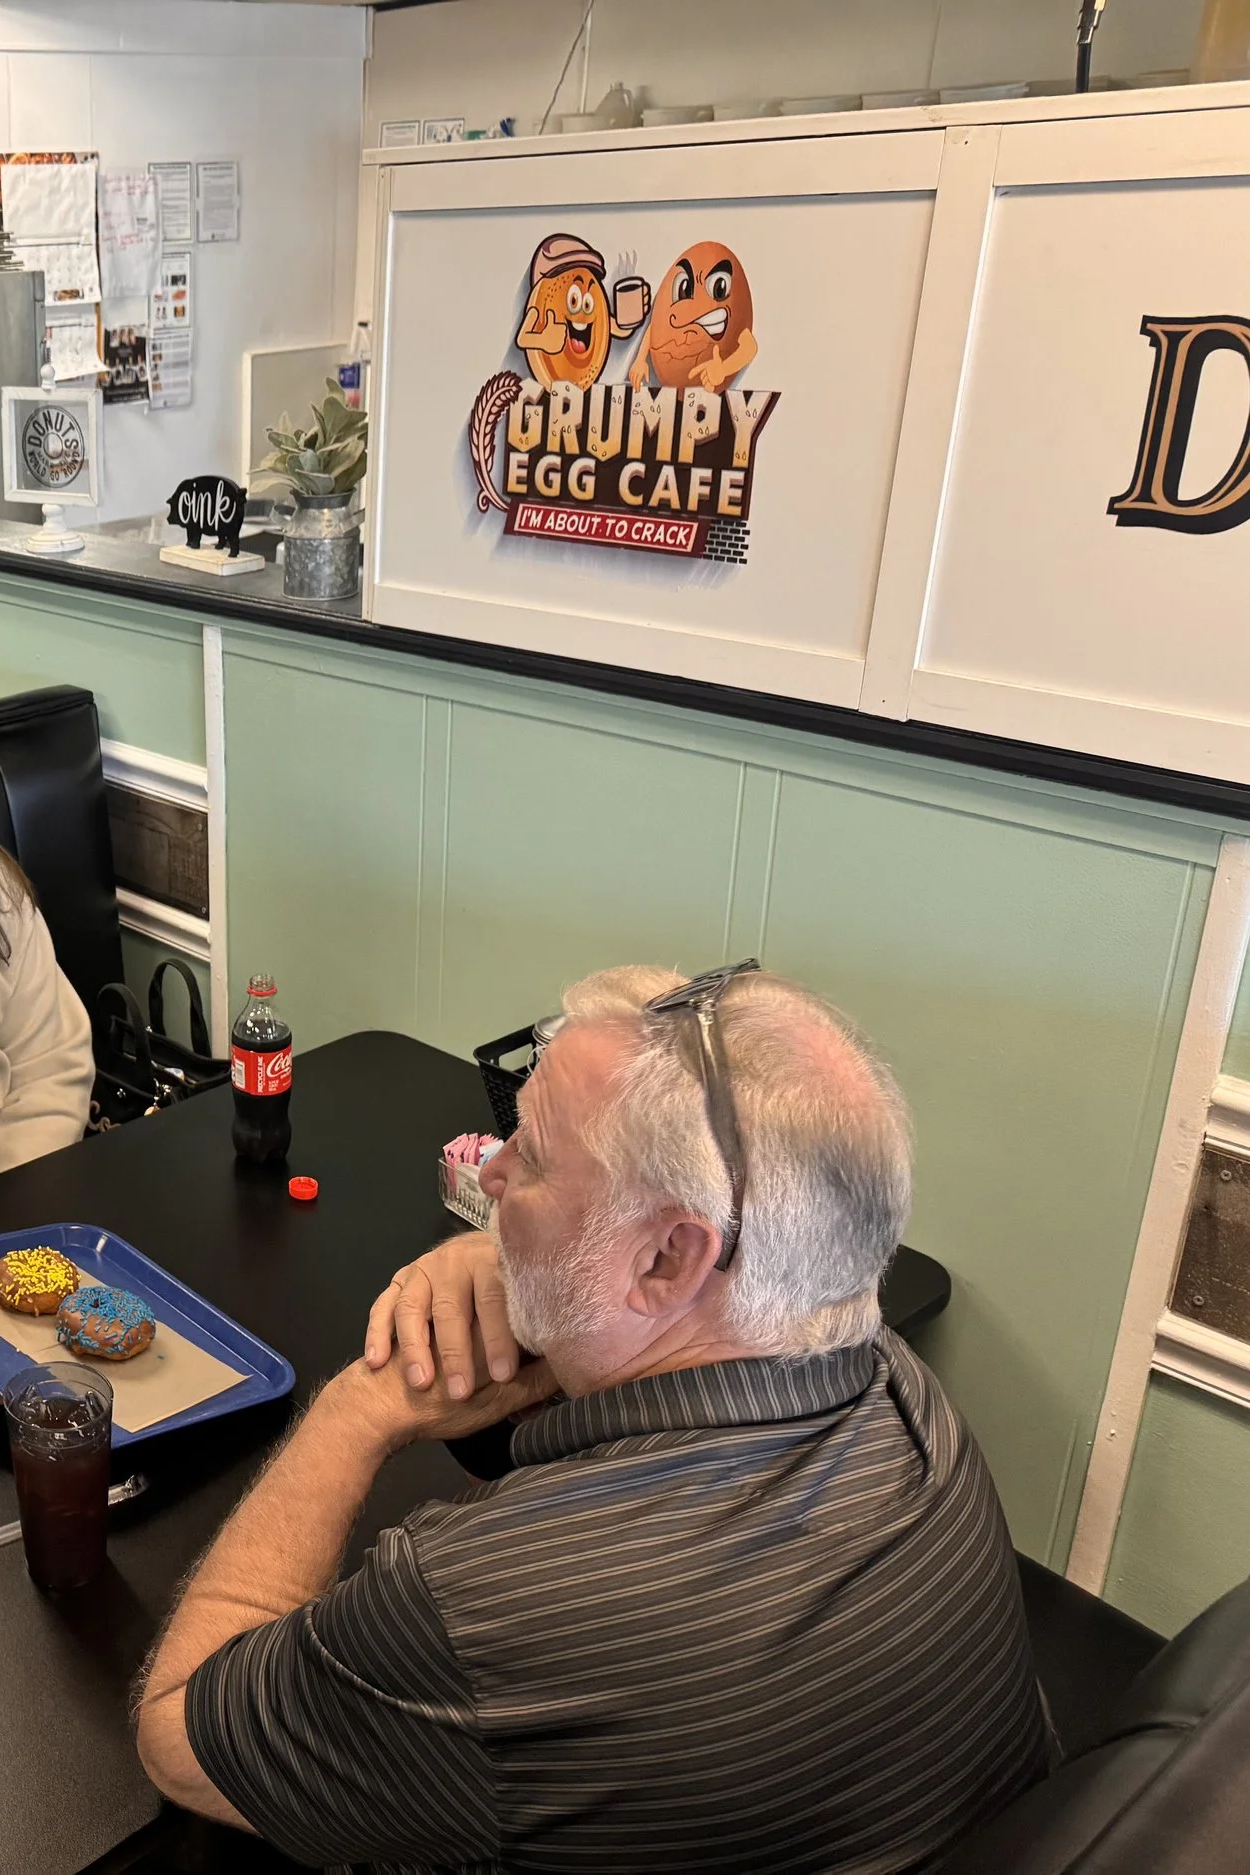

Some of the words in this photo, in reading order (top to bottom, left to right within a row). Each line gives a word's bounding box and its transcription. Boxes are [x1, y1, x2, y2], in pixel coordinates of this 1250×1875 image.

[28, 410, 79, 450] DONUTS
[507, 378, 780, 468] GRUMPY
[178, 480, 236, 531] oink
[507, 452, 597, 500] EGG
[618, 461, 746, 516] CAFE
[520, 508, 544, 529] I'M
[544, 512, 601, 535] ABOUT
[605, 519, 628, 538] TO
[631, 521, 690, 546] CRACK
